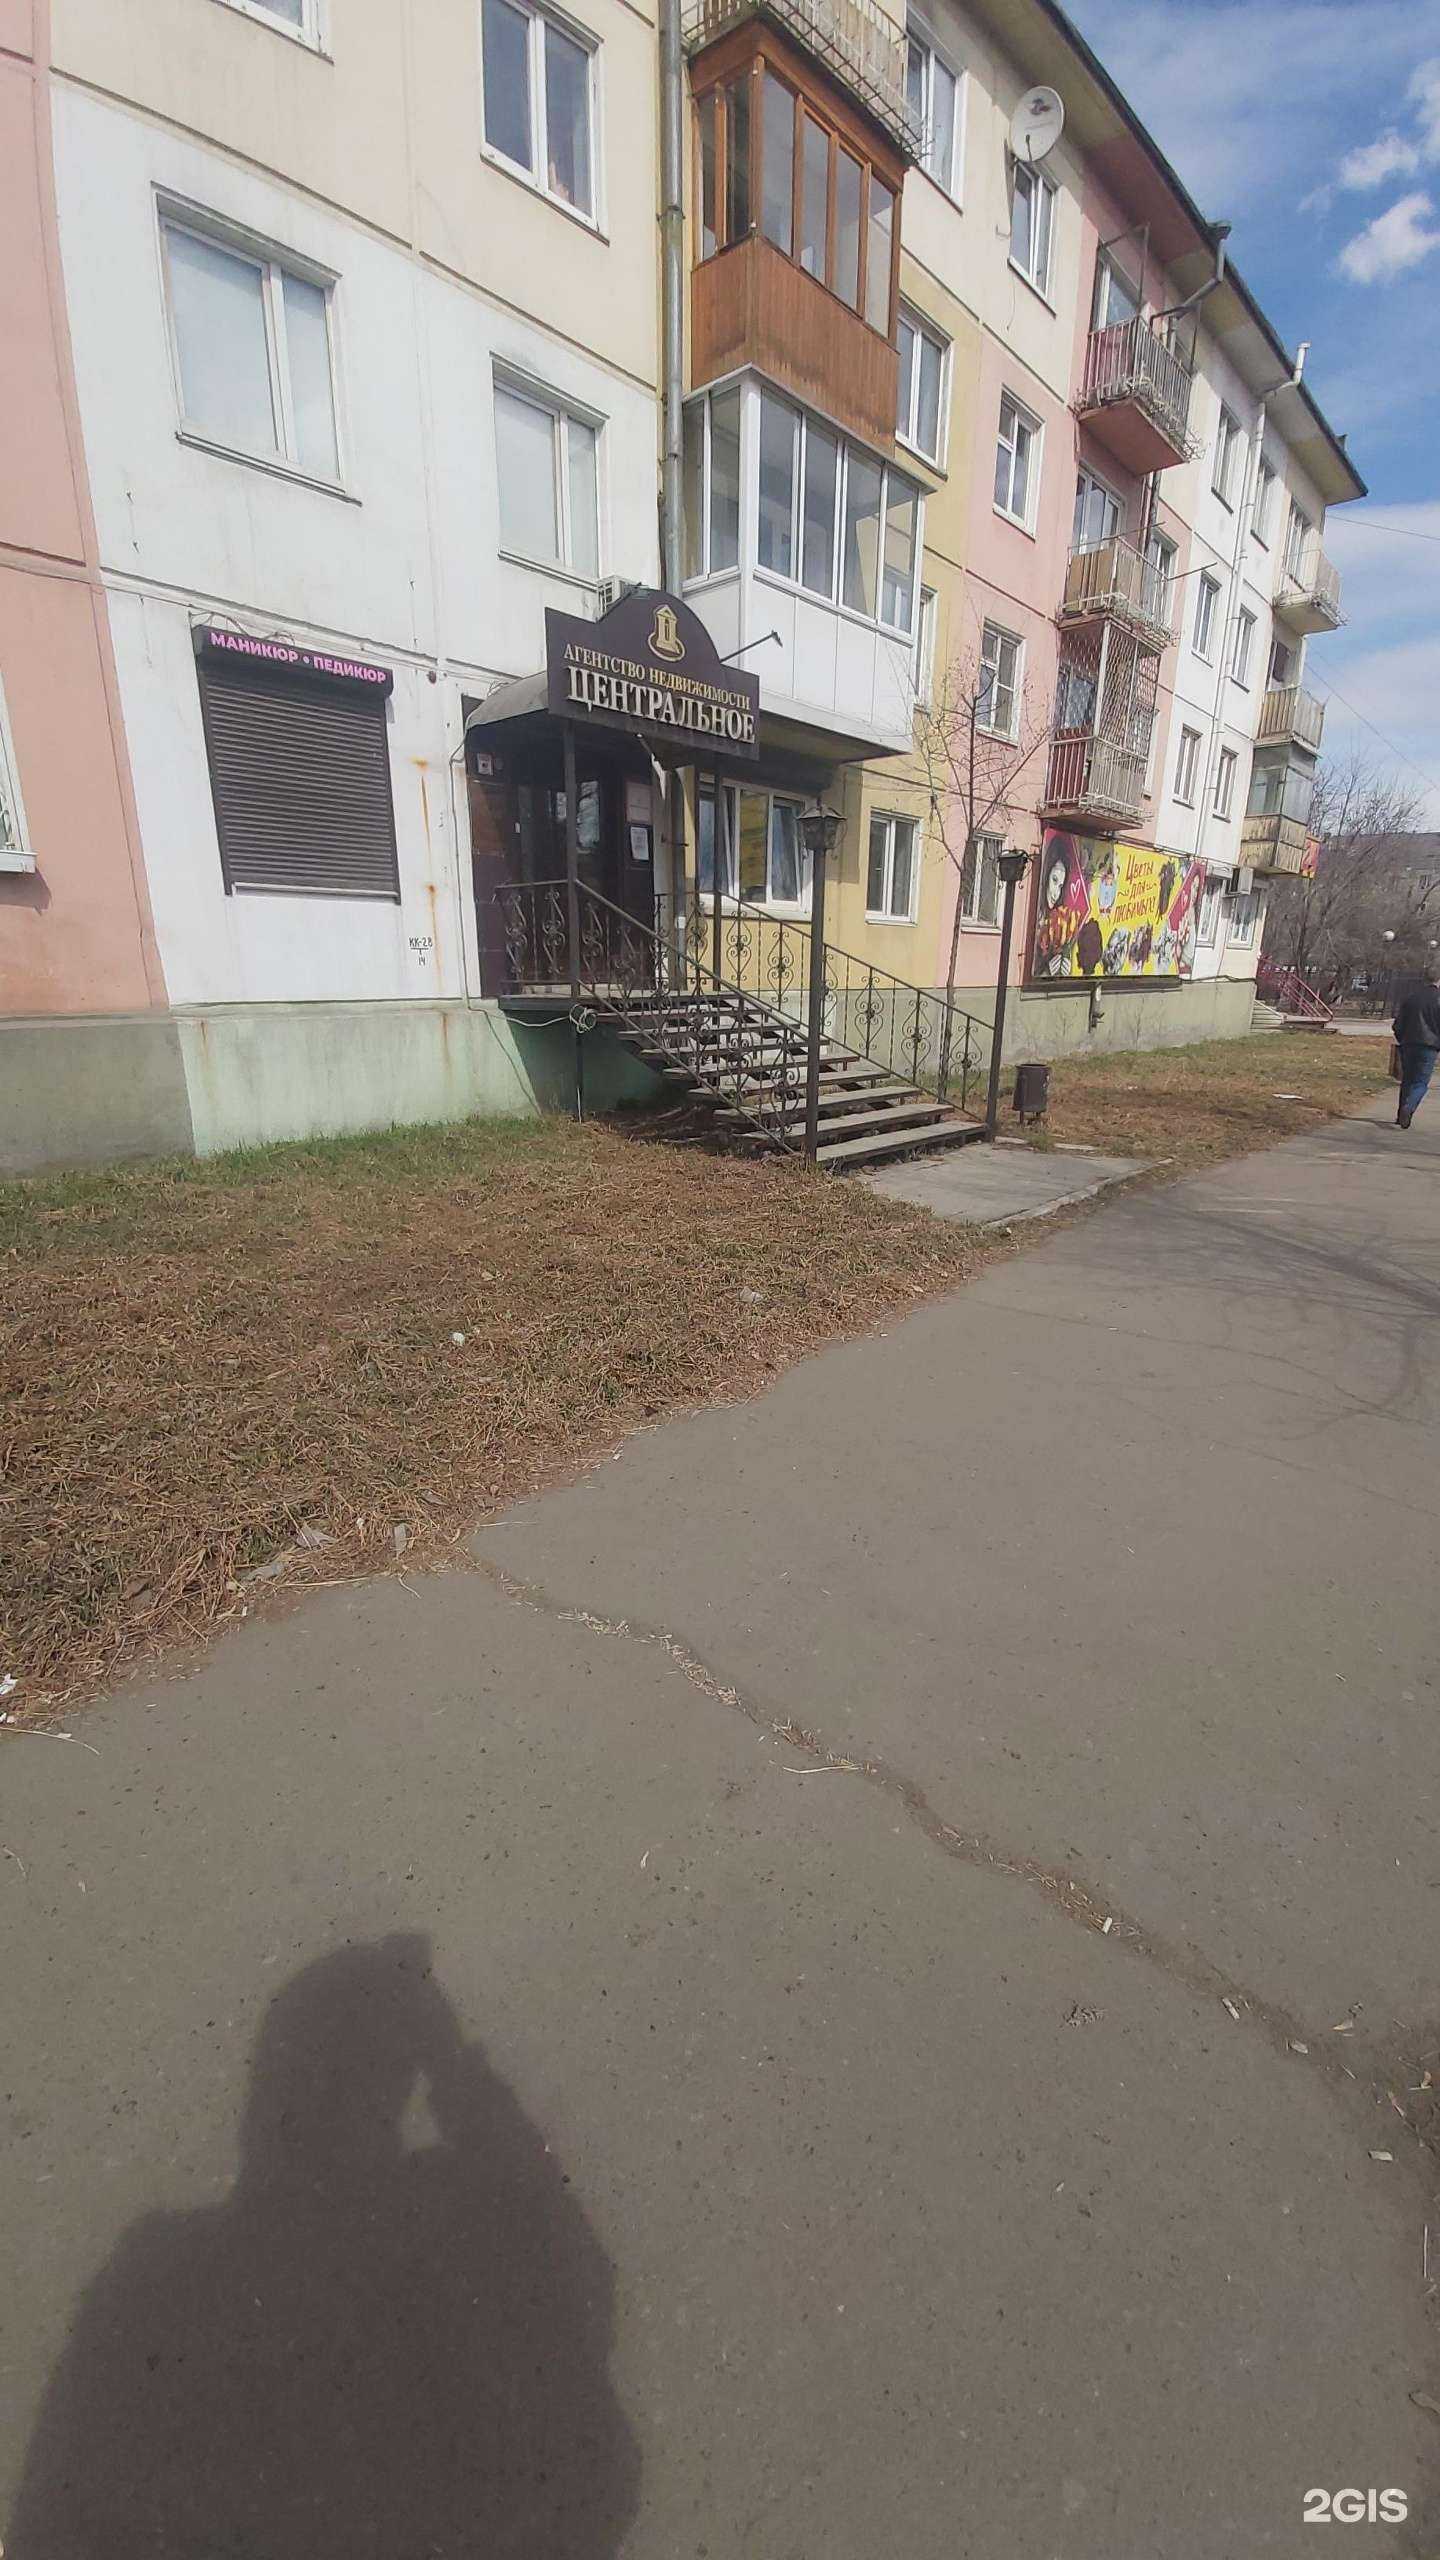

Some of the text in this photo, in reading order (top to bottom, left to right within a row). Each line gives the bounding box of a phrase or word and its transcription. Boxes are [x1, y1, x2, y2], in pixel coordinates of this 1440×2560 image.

[211, 632, 386, 684] МАНИКЮР ПЕДИКЮР
[564, 643, 750, 710] АГЕНТСТВО НЕДВИЖИМОСТИ
[566, 665, 755, 744] ЦЕНТРАЛЬНОЕ
